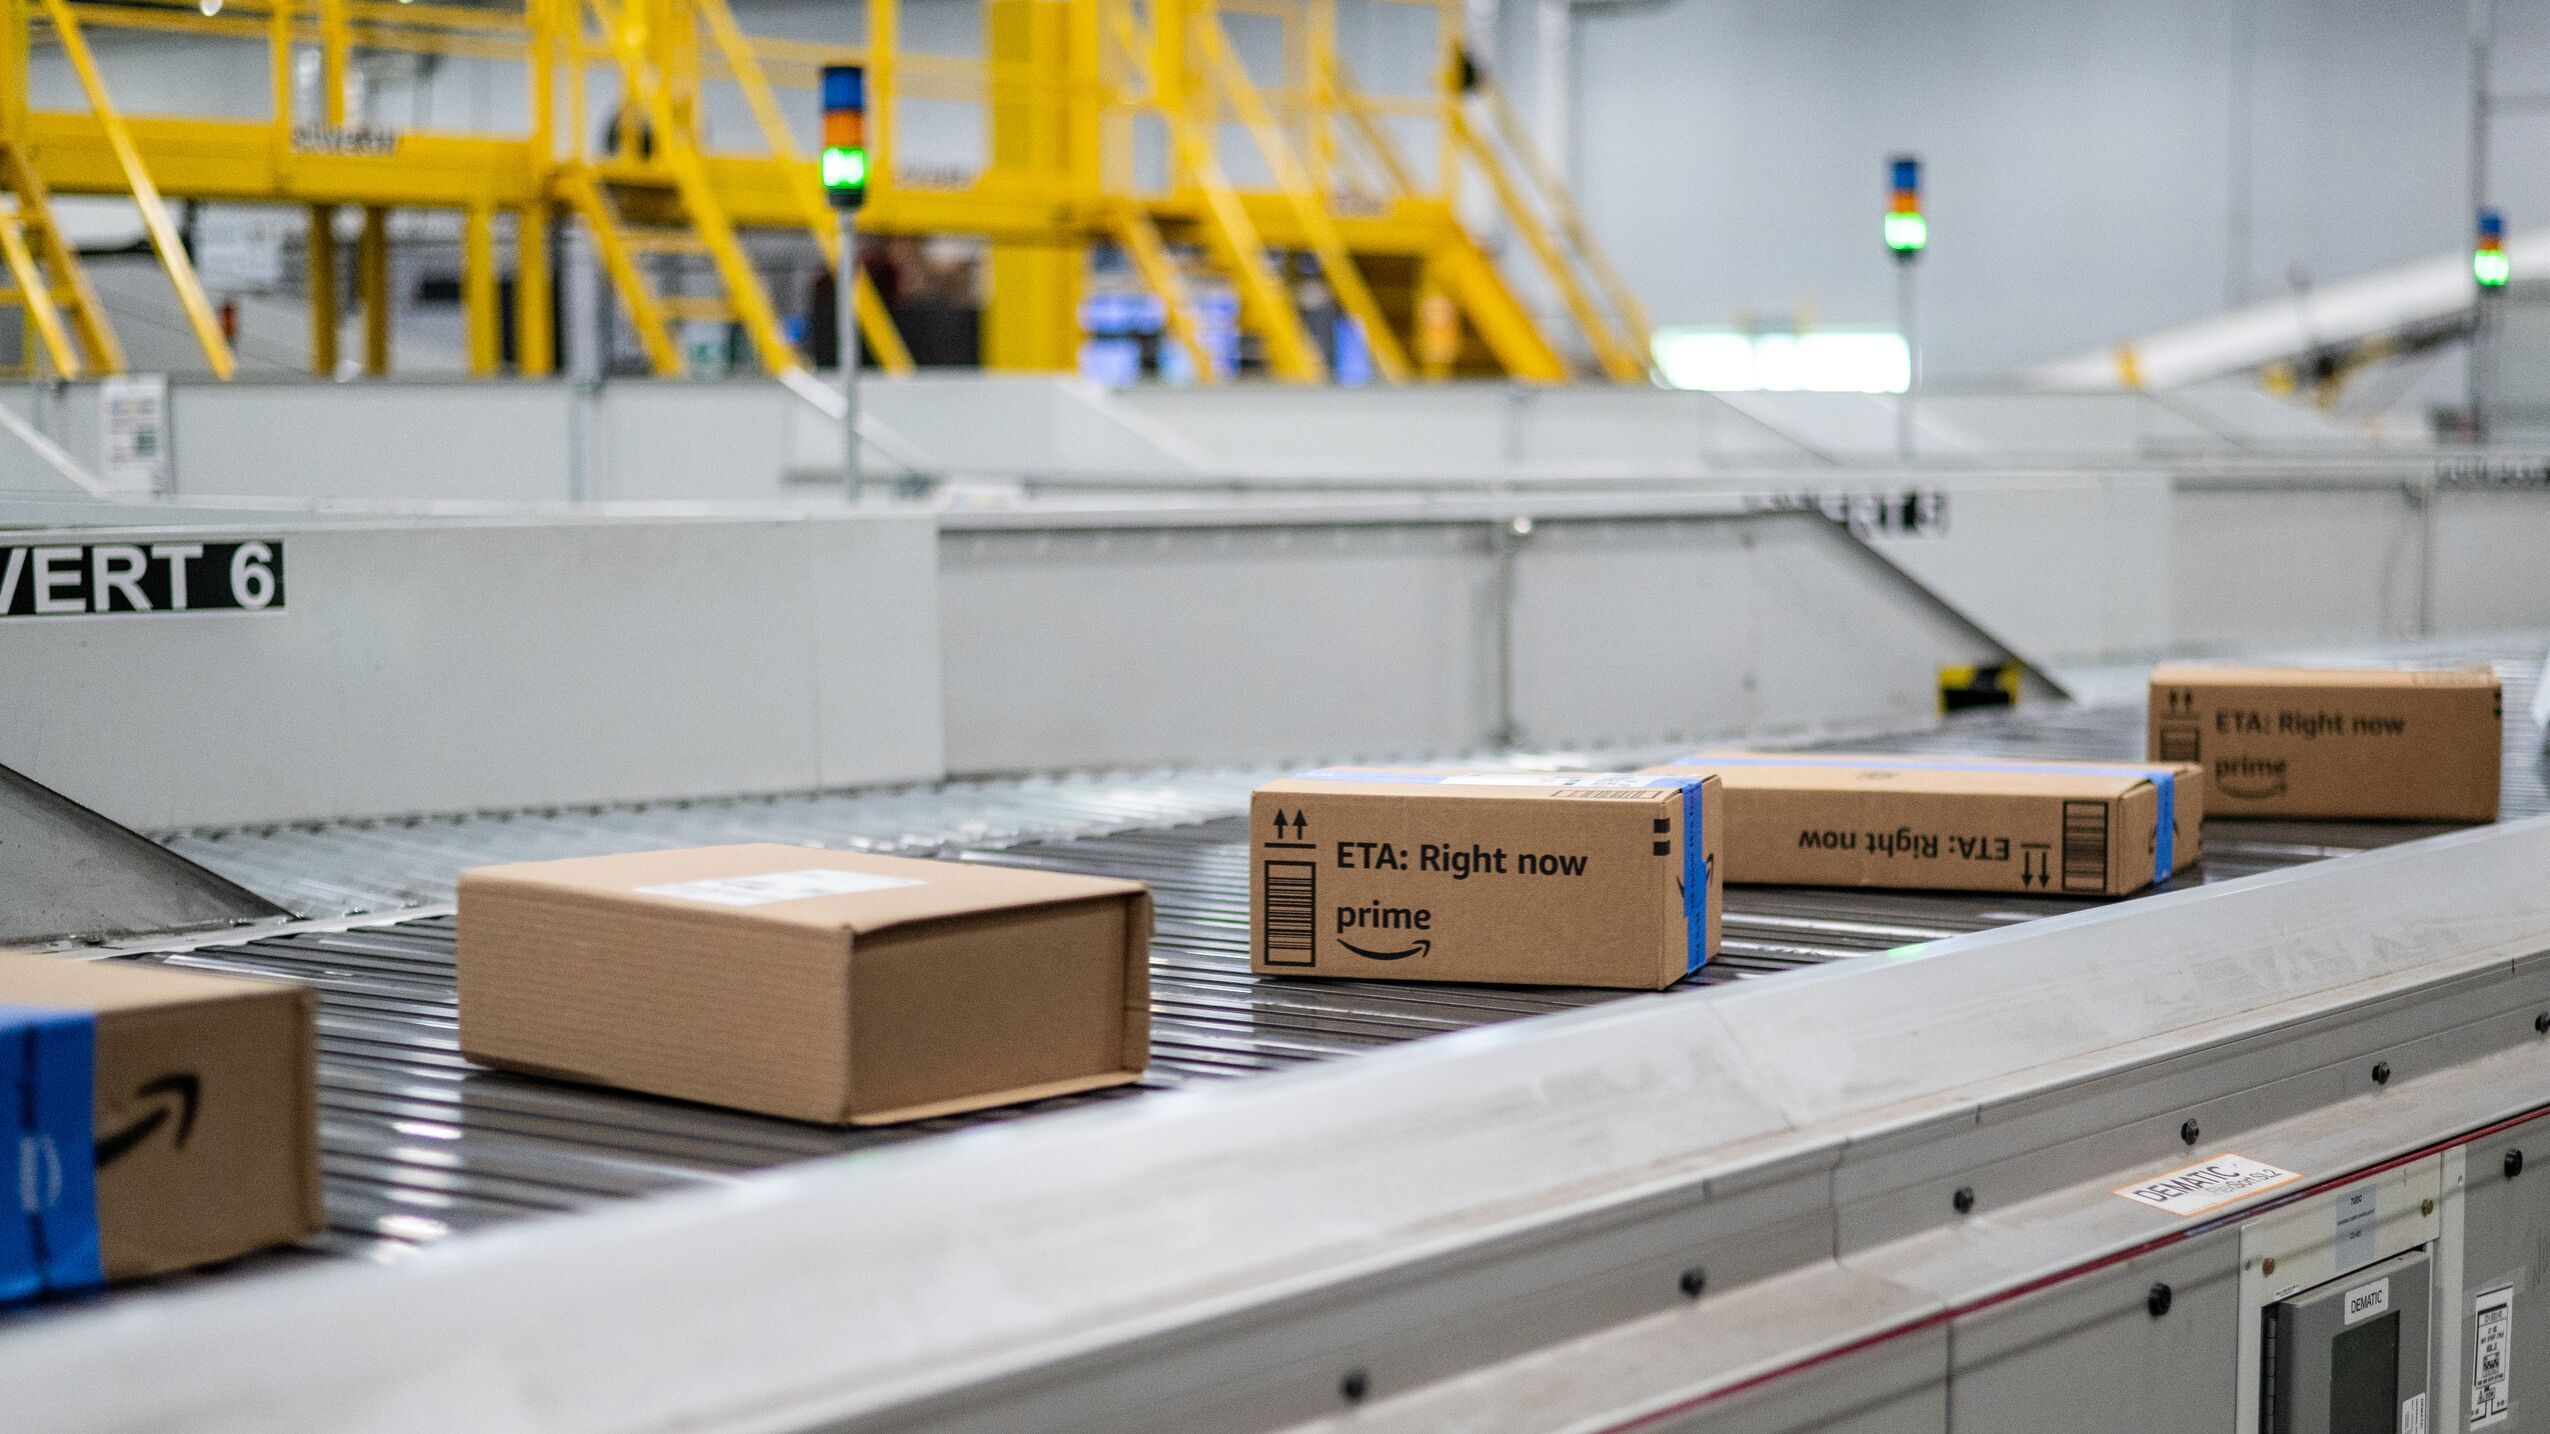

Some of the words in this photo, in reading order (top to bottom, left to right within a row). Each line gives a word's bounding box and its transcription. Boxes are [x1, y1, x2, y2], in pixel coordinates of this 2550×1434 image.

[231, 541, 276, 609] 6
[2215, 708, 2272, 734] ETA:
[2279, 709, 2343, 740] Right
[2352, 716, 2405, 736] now
[2215, 756, 2287, 783] prime
[1798, 829, 1856, 849] now
[1866, 826, 1938, 858] Right
[1949, 833, 2010, 861] ETA:
[1337, 841, 1408, 871] ETA:
[1420, 843, 1507, 880] Right
[1518, 853, 1588, 876] now
[1336, 900, 1431, 934] prime
[2133, 1166, 2240, 1203] DEMATIC
[2351, 1289, 2383, 1314] DEMATIC
